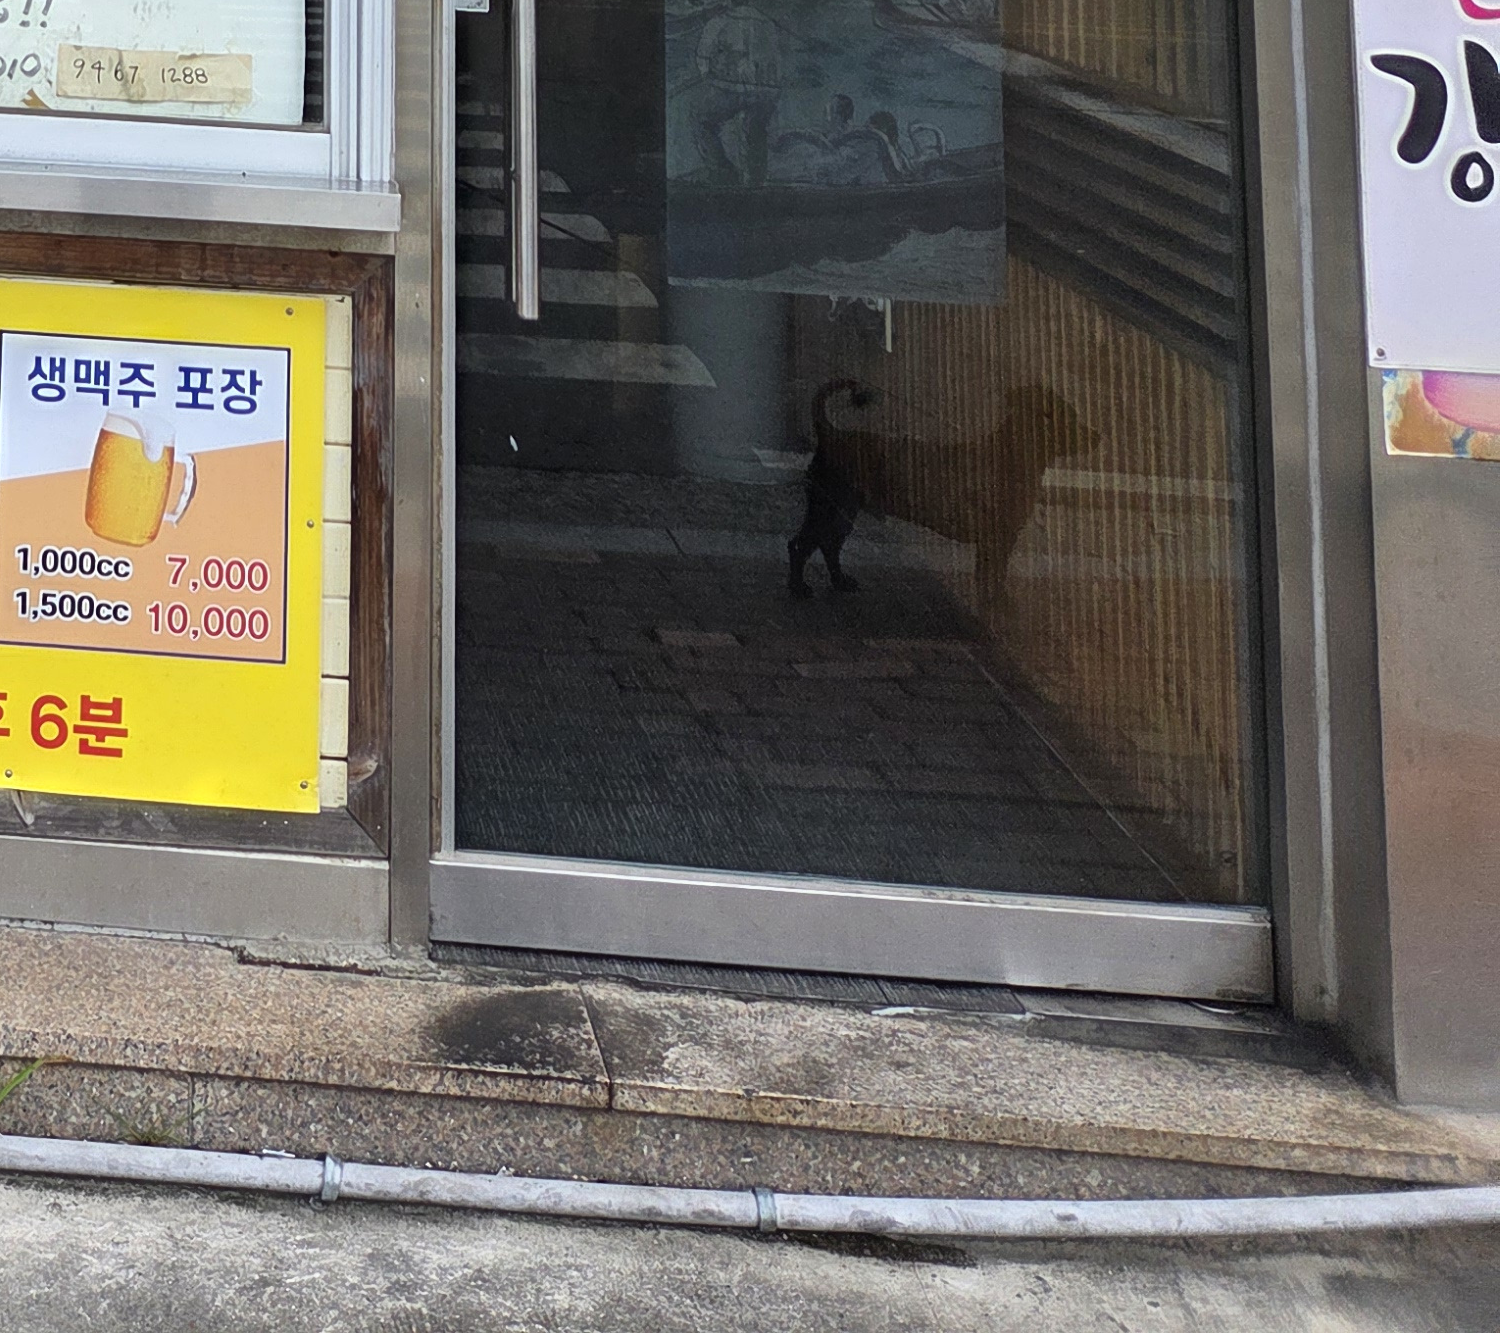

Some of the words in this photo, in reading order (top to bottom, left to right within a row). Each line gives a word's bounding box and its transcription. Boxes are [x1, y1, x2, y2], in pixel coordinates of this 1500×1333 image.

[73, 58, 139, 85] 9467
[161, 67, 209, 85] 1288
[28, 355, 156, 409] 생맥주
[175, 365, 263, 415] 포장
[16, 547, 132, 579] 1,000cc
[167, 557, 269, 592] 7,000
[15, 591, 131, 622] 1,500cc
[149, 602, 270, 640] 10,000
[29, 693, 129, 759] 6분
